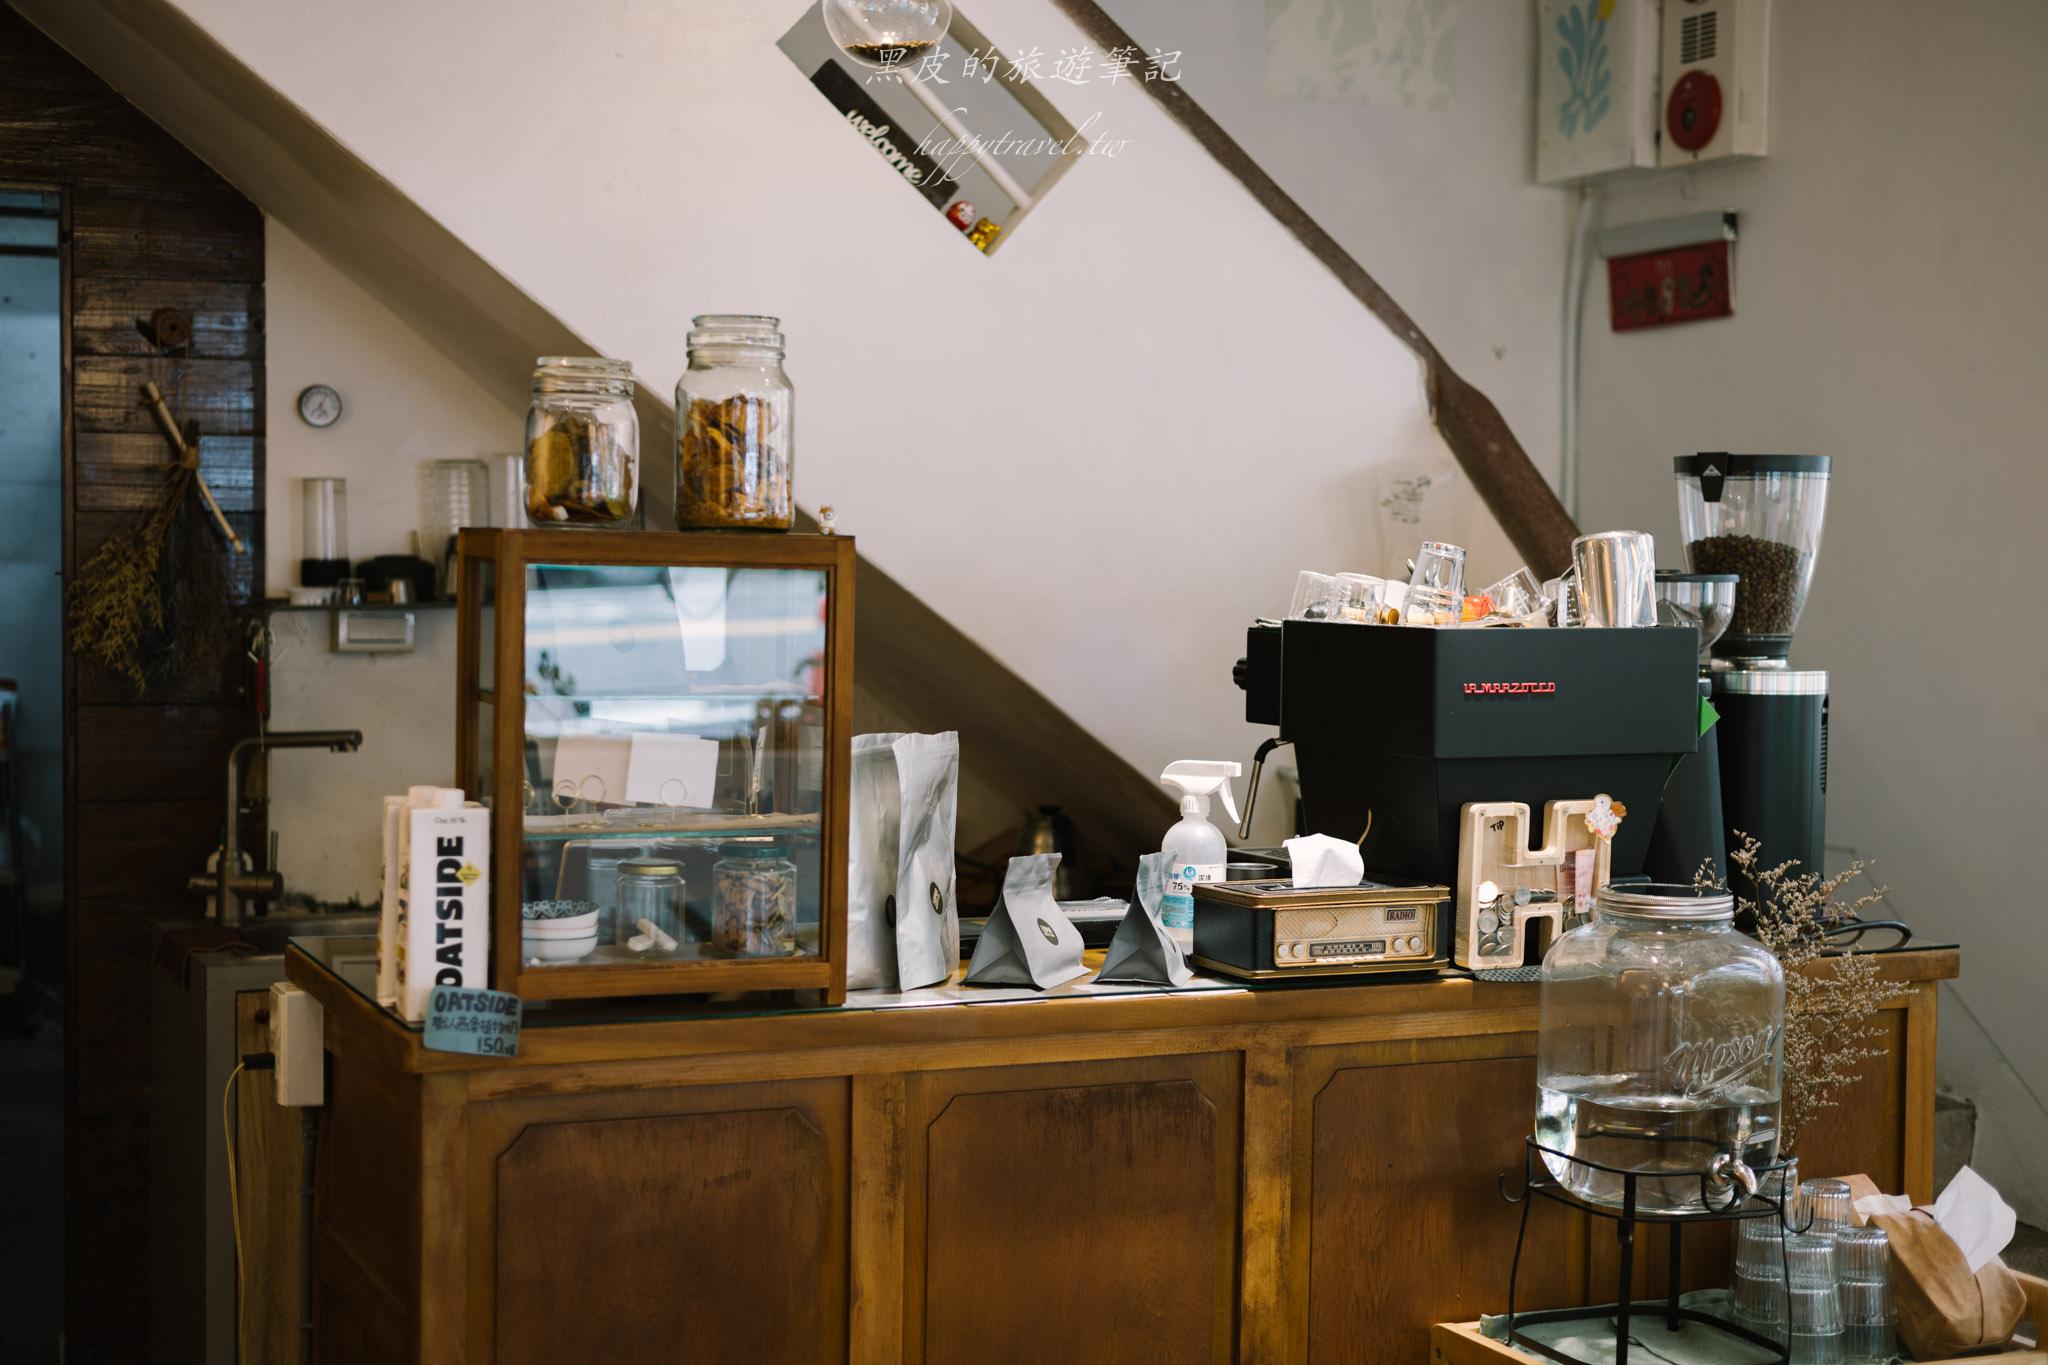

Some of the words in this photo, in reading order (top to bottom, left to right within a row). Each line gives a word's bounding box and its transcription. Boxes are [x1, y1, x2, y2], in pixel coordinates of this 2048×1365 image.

[435, 836, 464, 988] OATSIDE
[1389, 910, 1414, 921] RADIO
[435, 991, 519, 1016] OATSIDE
